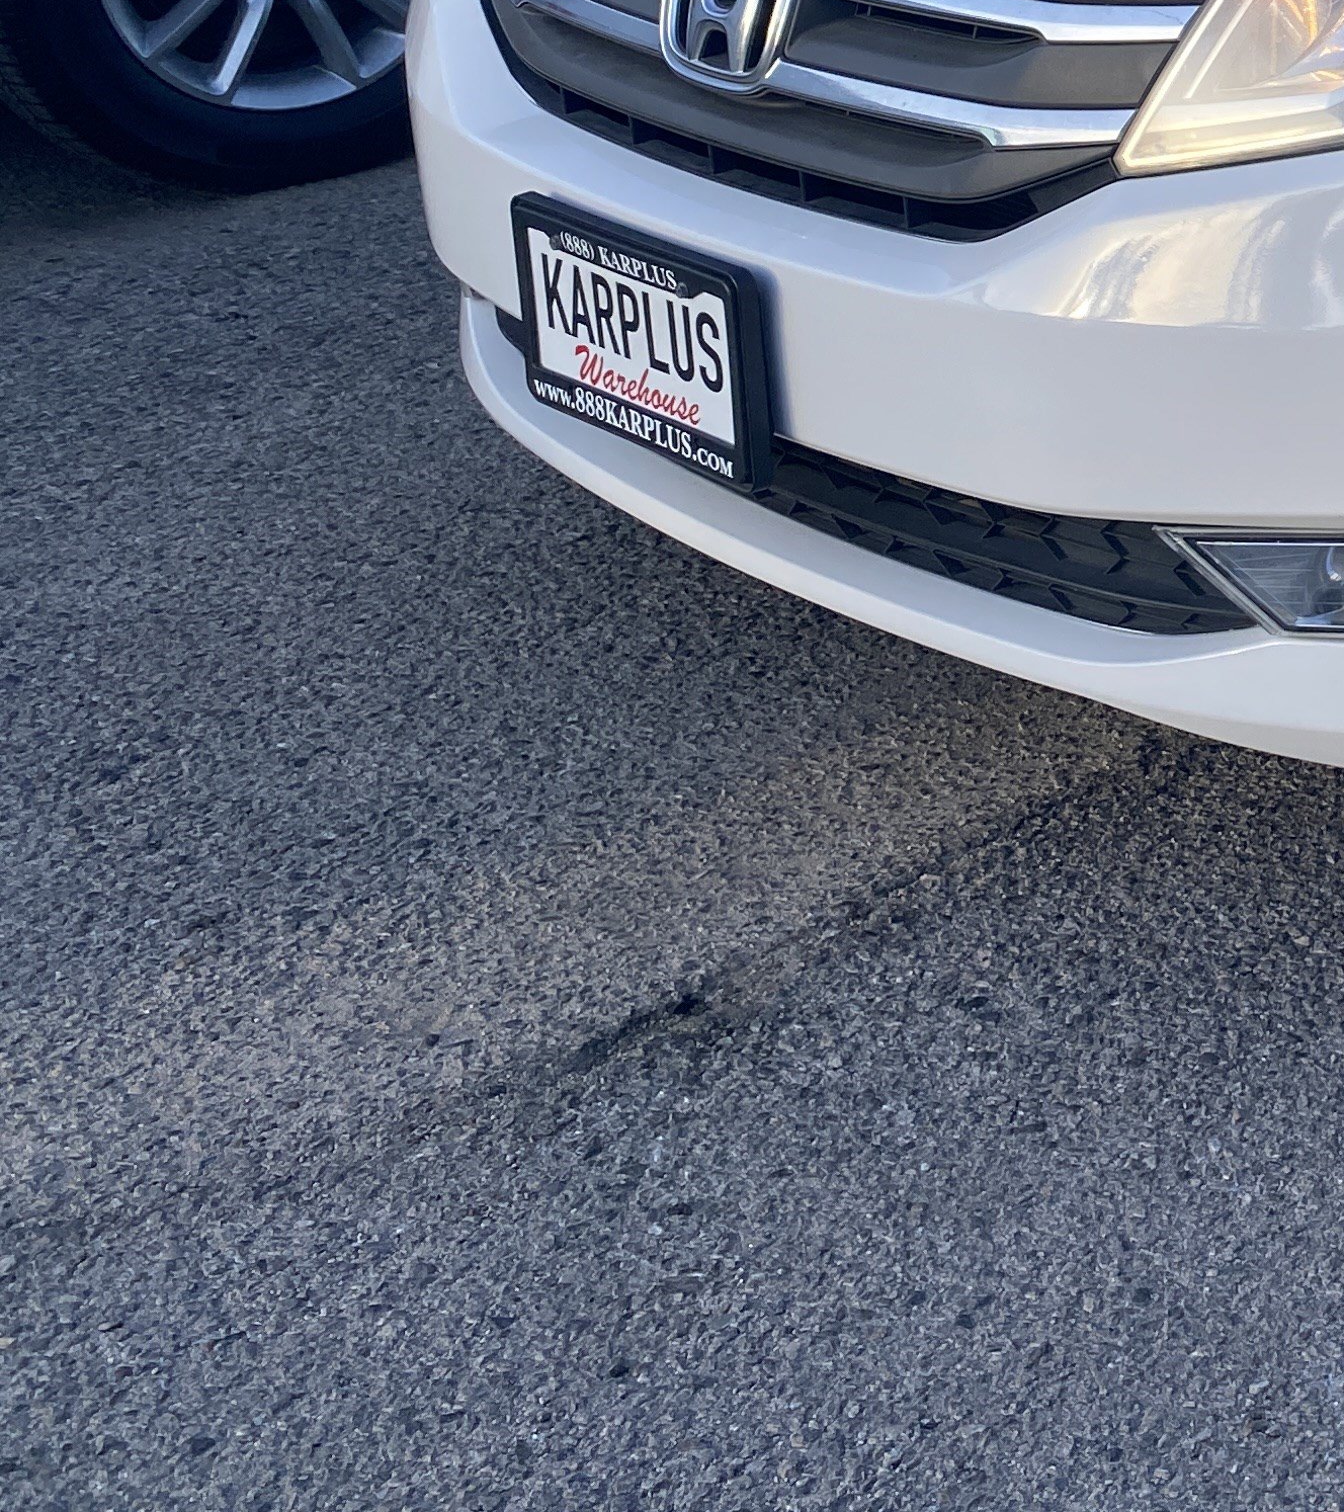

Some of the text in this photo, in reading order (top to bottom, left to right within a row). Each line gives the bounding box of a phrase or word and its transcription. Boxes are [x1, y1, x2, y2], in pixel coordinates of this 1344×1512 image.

[560, 231, 678, 290] (888) KARPLUS
[541, 252, 724, 393] KARPLUS
[575, 344, 700, 426] Warehouse
